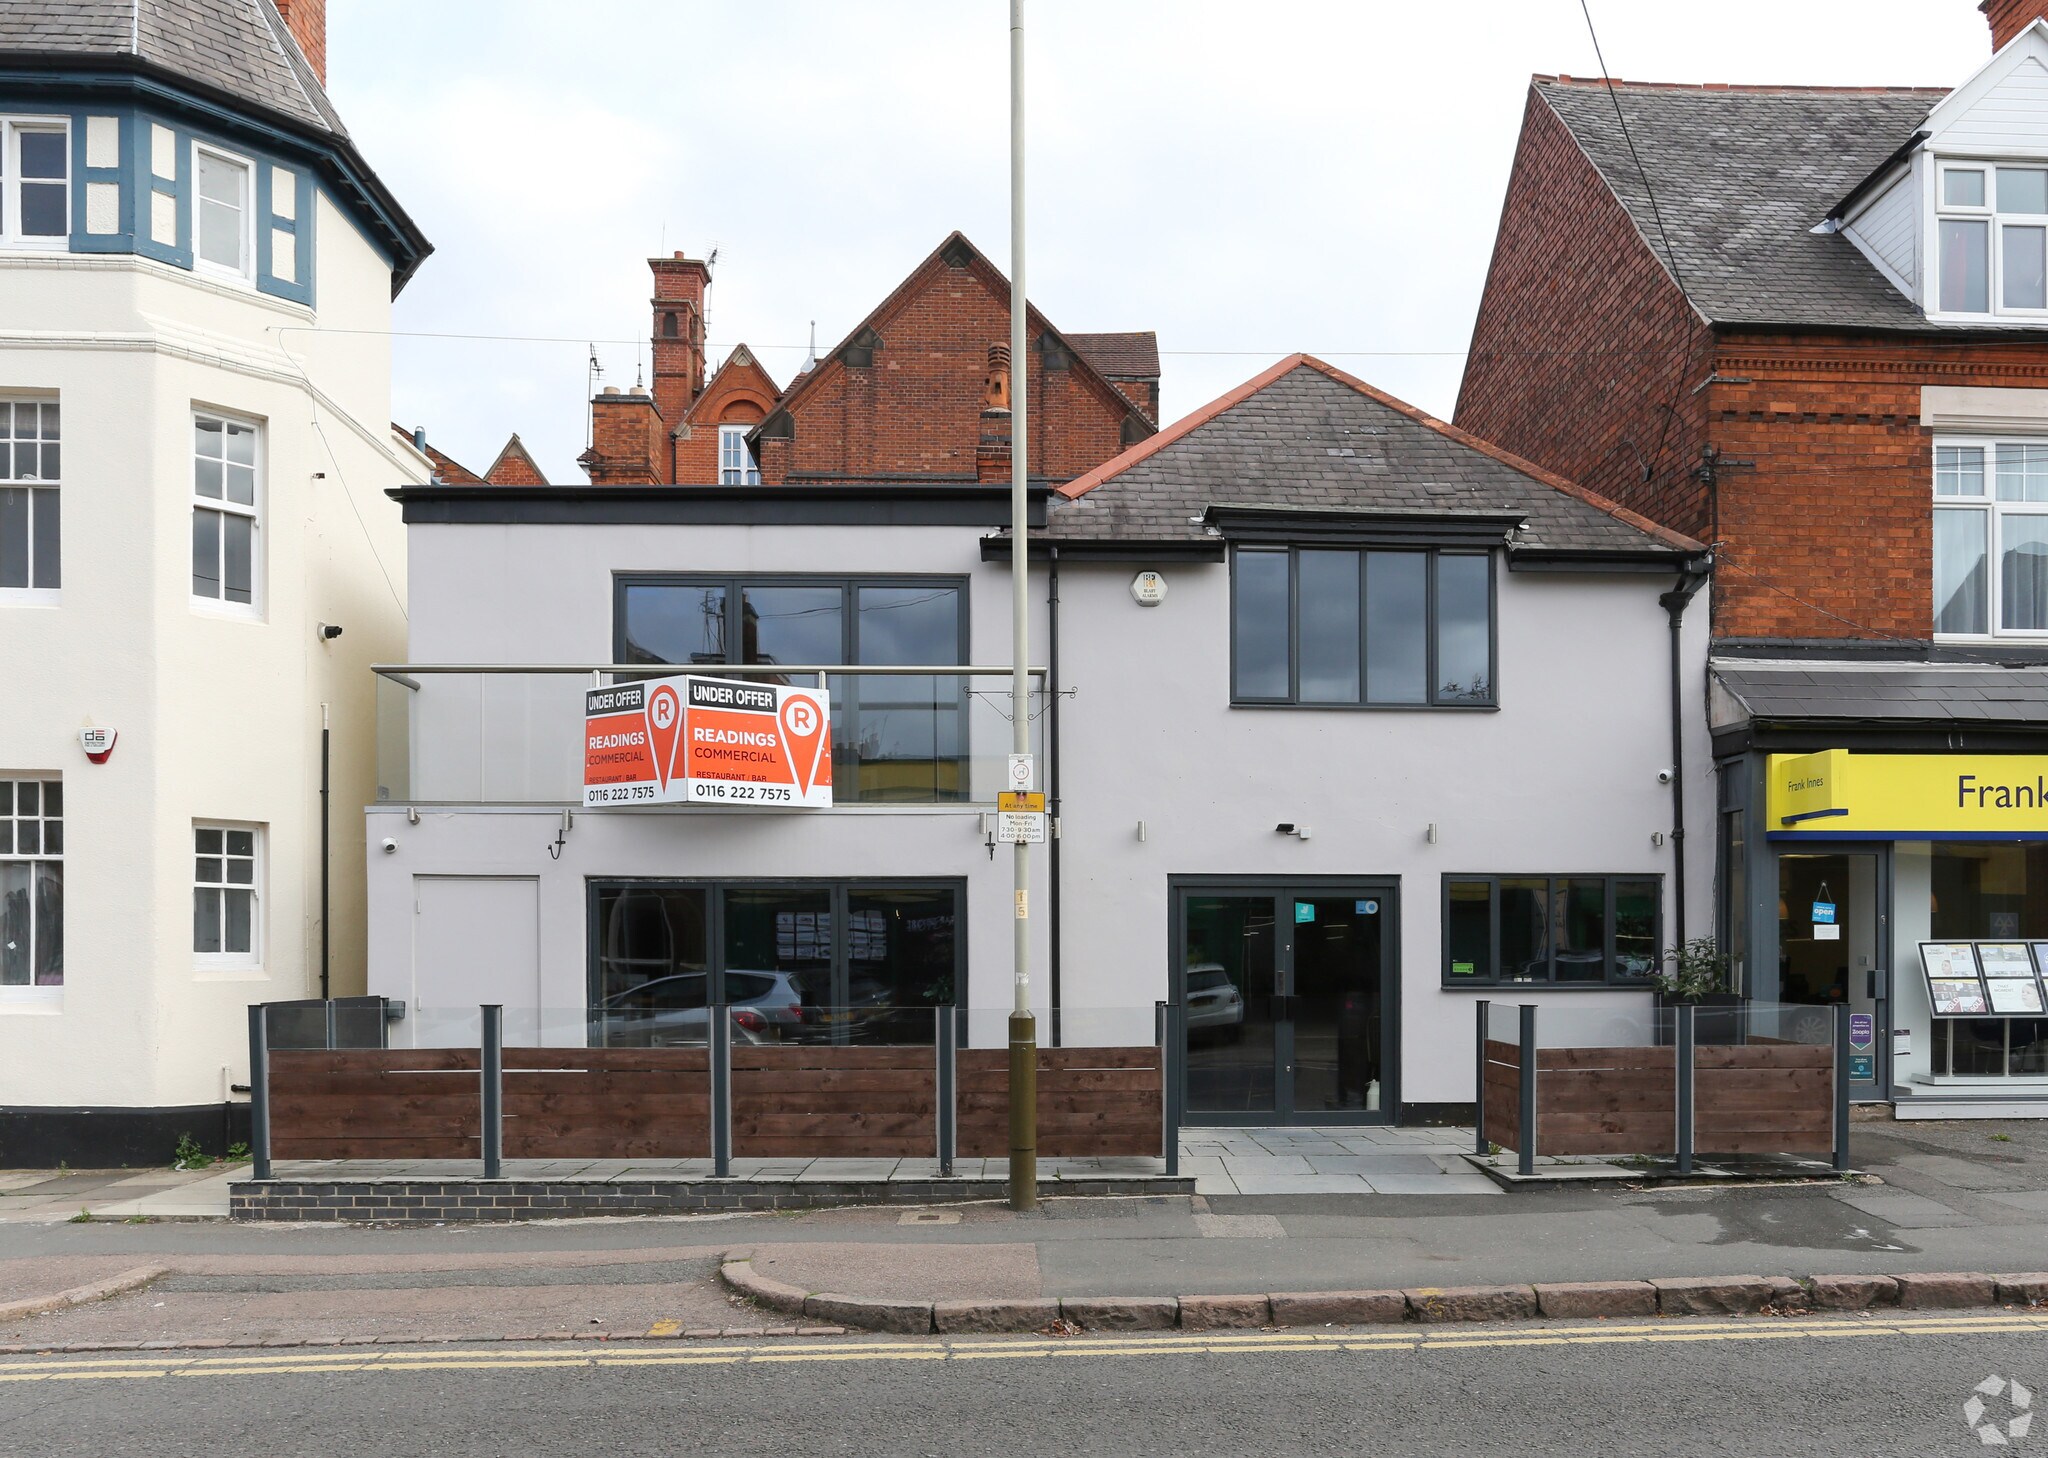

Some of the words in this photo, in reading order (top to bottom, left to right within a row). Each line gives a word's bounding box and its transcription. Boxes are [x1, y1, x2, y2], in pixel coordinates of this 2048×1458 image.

[588, 693, 614, 711] UNDER
[616, 690, 641, 707] OFFER
[693, 685, 733, 704] UNDER
[736, 690, 773, 707] OFFER
[658, 699, 669, 721] R
[794, 707, 810, 729] R
[589, 732, 645, 749] READINGS
[694, 727, 777, 747] READINGS
[589, 751, 644, 766] COMMERCIAL
[694, 748, 777, 764] COMMERCIAL
[589, 775, 622, 784] RESTAURANT
[696, 771, 746, 781] RESTAURANT
[1788, 778, 1805, 792] Frank
[1806, 776, 1824, 789] Innes
[589, 789, 608, 802] 0116
[611, 788, 629, 800] 222
[632, 786, 655, 799] 7575
[696, 785, 726, 798] 0116
[730, 787, 755, 799] 222
[760, 788, 791, 801] 7575
[1018, 906, 1025, 917] 5
[1814, 908, 1834, 916] open
[1945, 997, 1960, 1013] SOLD
[1970, 997, 1984, 1012] SOLD
